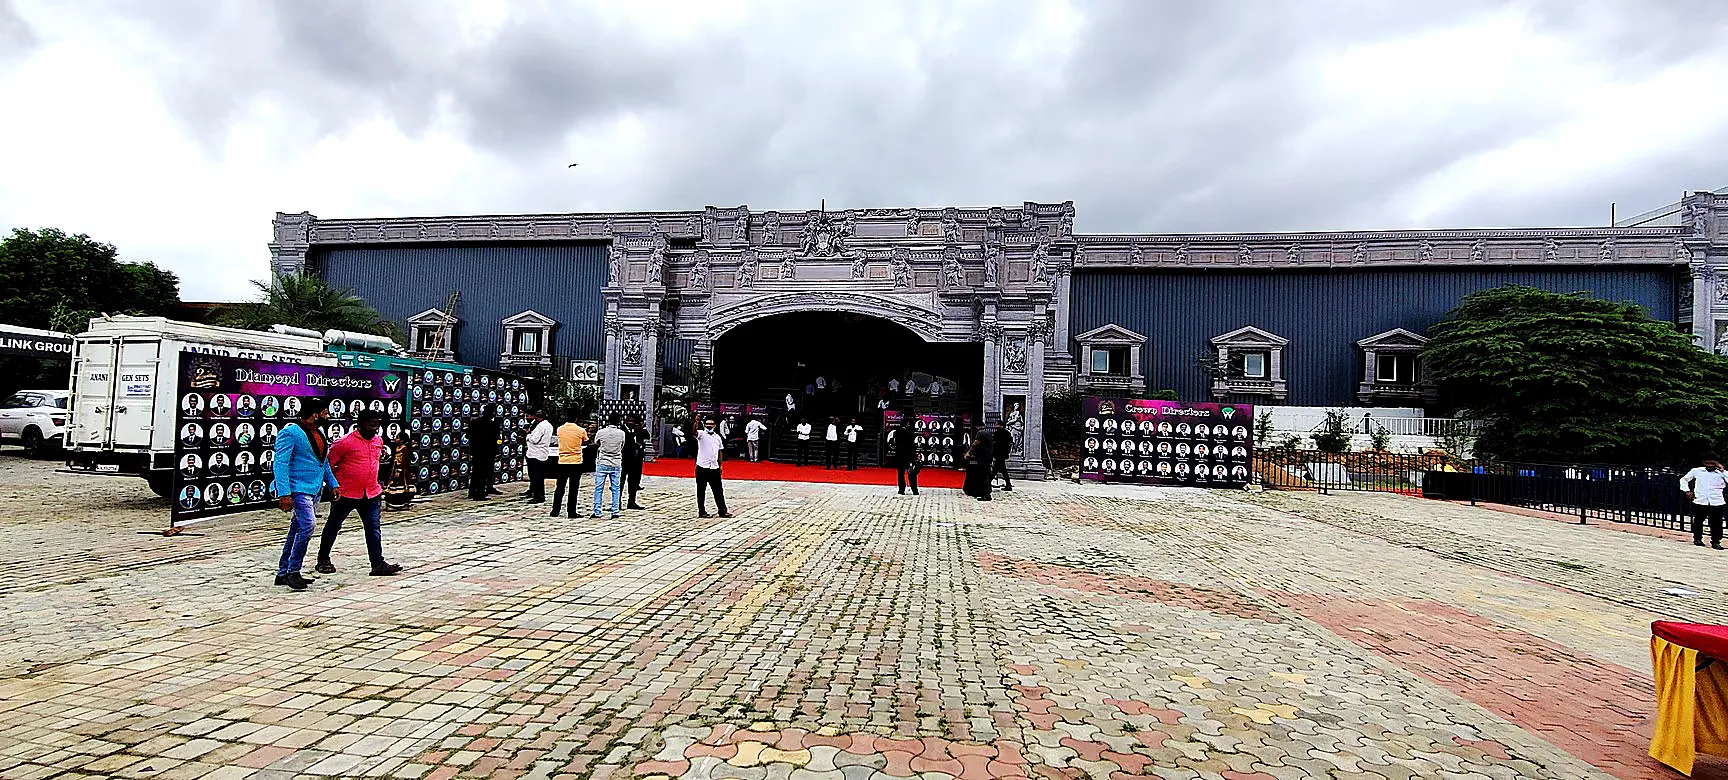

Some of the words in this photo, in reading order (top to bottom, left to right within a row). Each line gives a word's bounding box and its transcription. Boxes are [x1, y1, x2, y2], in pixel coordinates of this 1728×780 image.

[0, 338, 32, 350] LINK
[134, 374, 150, 382] SETS
[235, 368, 299, 387] Diamond
[305, 373, 372, 389] Directors
[1125, 404, 1158, 416] Crown
[1161, 406, 1210, 418] Directors
